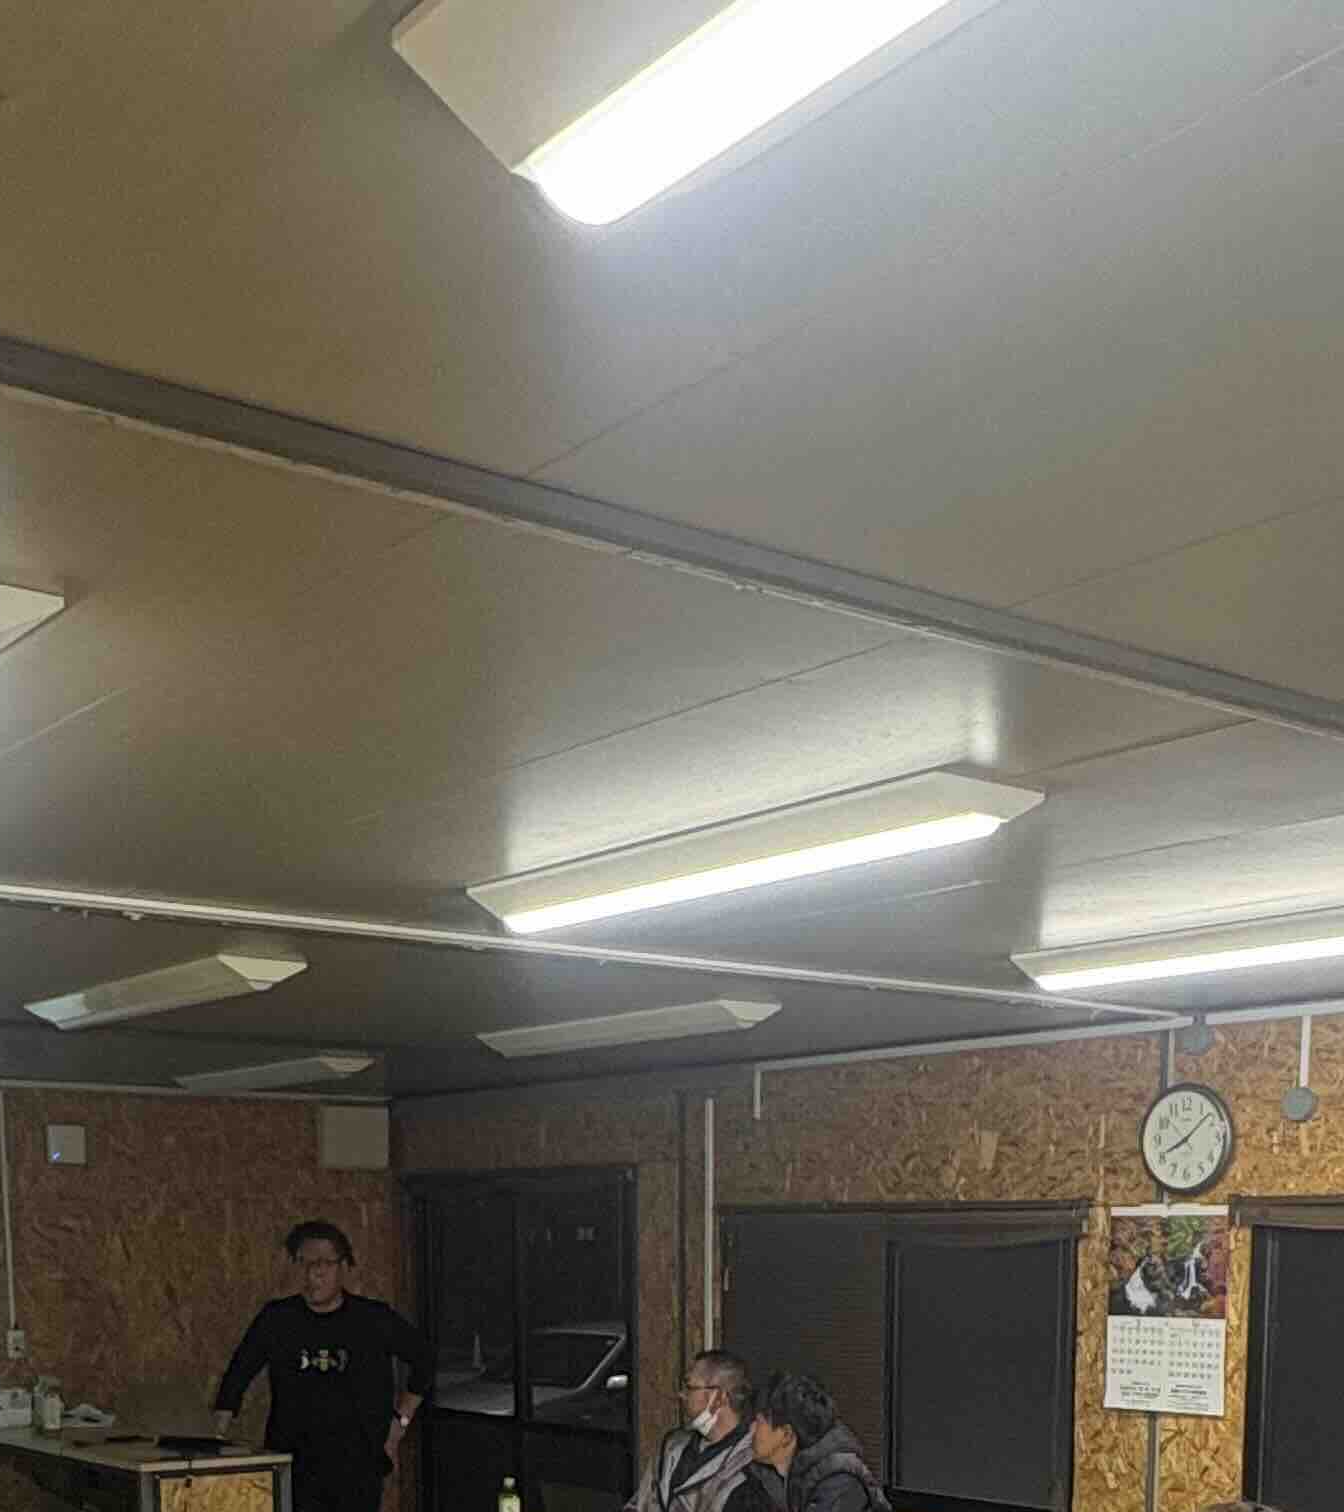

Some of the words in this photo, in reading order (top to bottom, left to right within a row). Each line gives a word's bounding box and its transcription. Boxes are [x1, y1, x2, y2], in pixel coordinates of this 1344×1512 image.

[1169, 1103, 1179, 1118] 11
[1182, 1095, 1193, 1112] 12
[1158, 1116, 1170, 1130] 10
[1158, 1152, 1167, 1165] 8
[1169, 1162, 1178, 1177] 7
[1182, 1167, 1191, 1181] 6
